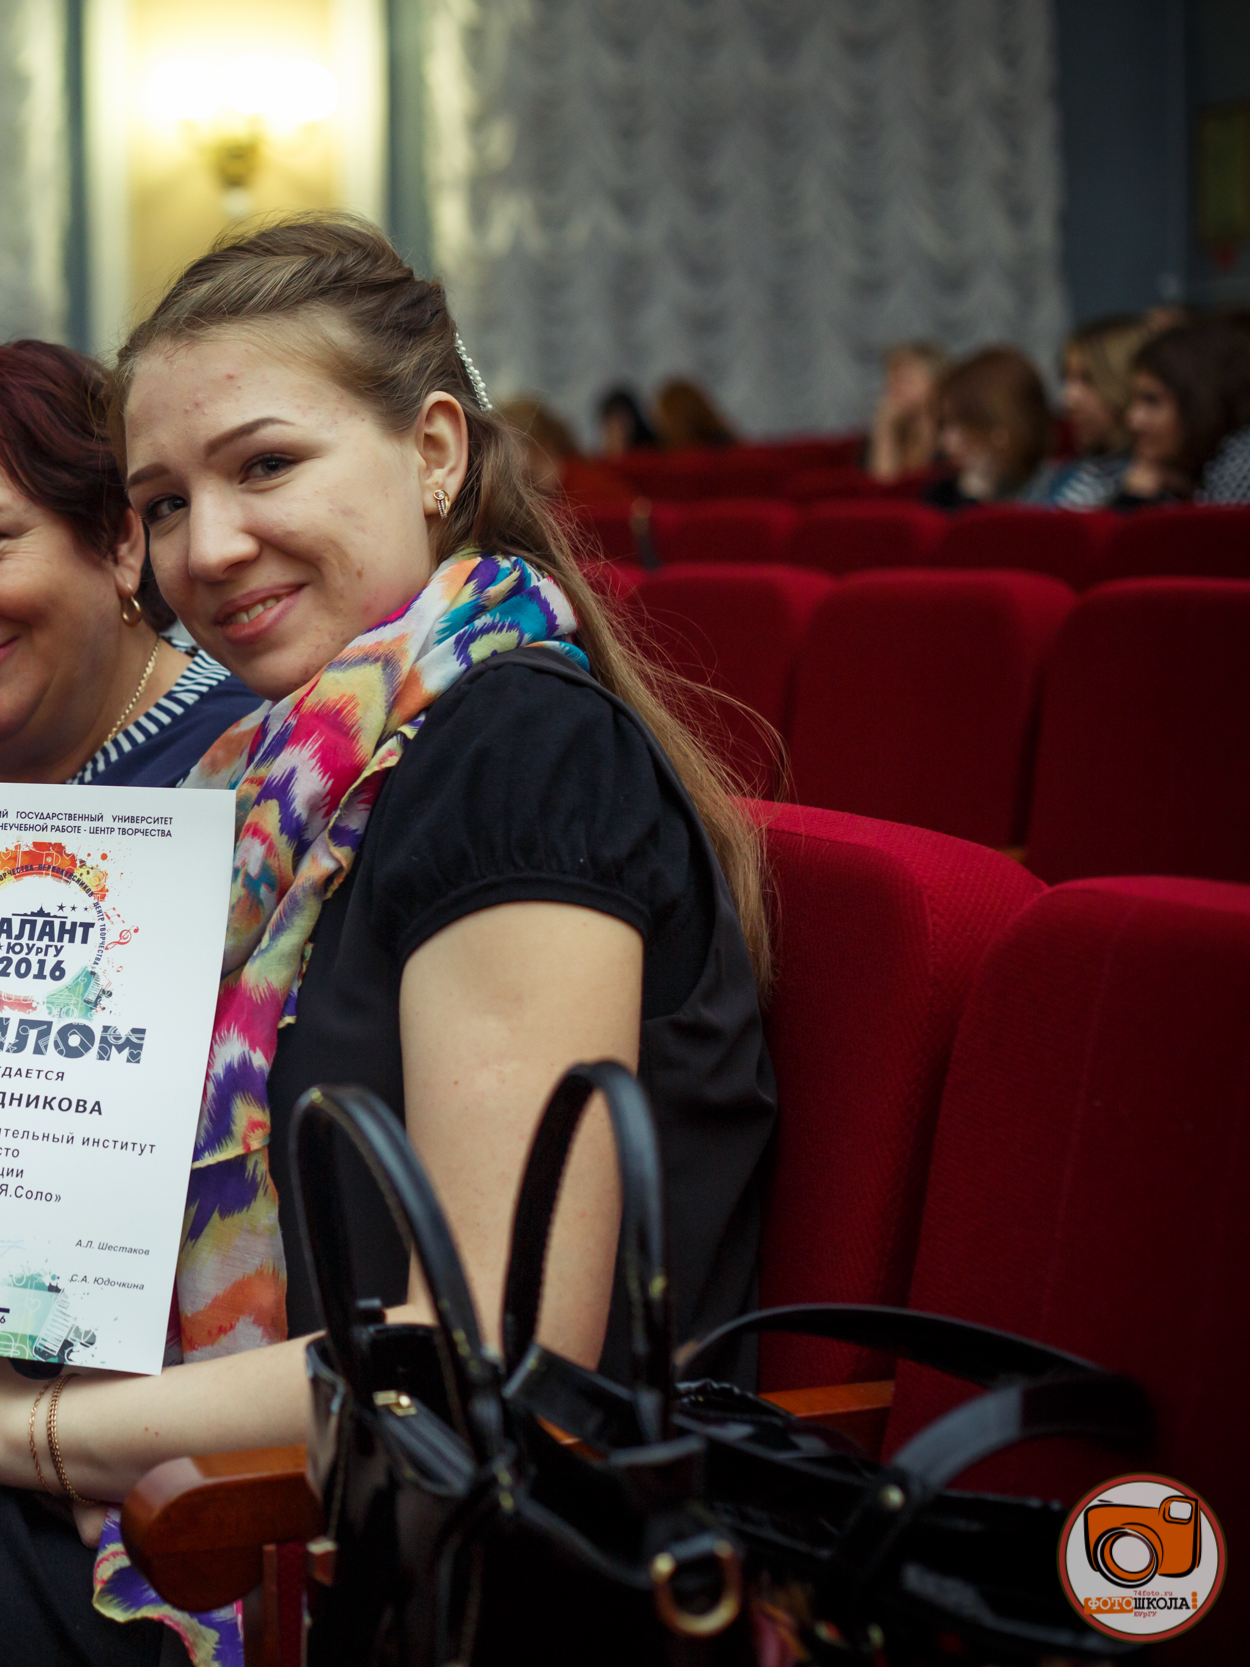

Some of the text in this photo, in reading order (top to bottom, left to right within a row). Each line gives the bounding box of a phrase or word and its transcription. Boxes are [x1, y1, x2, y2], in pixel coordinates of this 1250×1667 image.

[16, 811, 104, 822] ГОСУДАРСТВЕННЫЙ
[112, 815, 173, 825] УНИВЕРСИТЕТ
[50, 825, 81, 834] РАБОТЕ
[89, 826, 115, 835] ЦЕНТР
[118, 828, 172, 837] ТВОРЧЕСТВА
[38, 863, 94, 898] ПЕРВОКУРСНИКОВ
[93, 902, 105, 921] ЦЕНТР
[92, 924, 106, 965] ТВОРЧЕСТВА
[82, 1136, 156, 1156] институт
[75, 1239, 150, 1256] А.Л. Шестаков
[70, 1274, 144, 1290] С.А. Юдочкина
